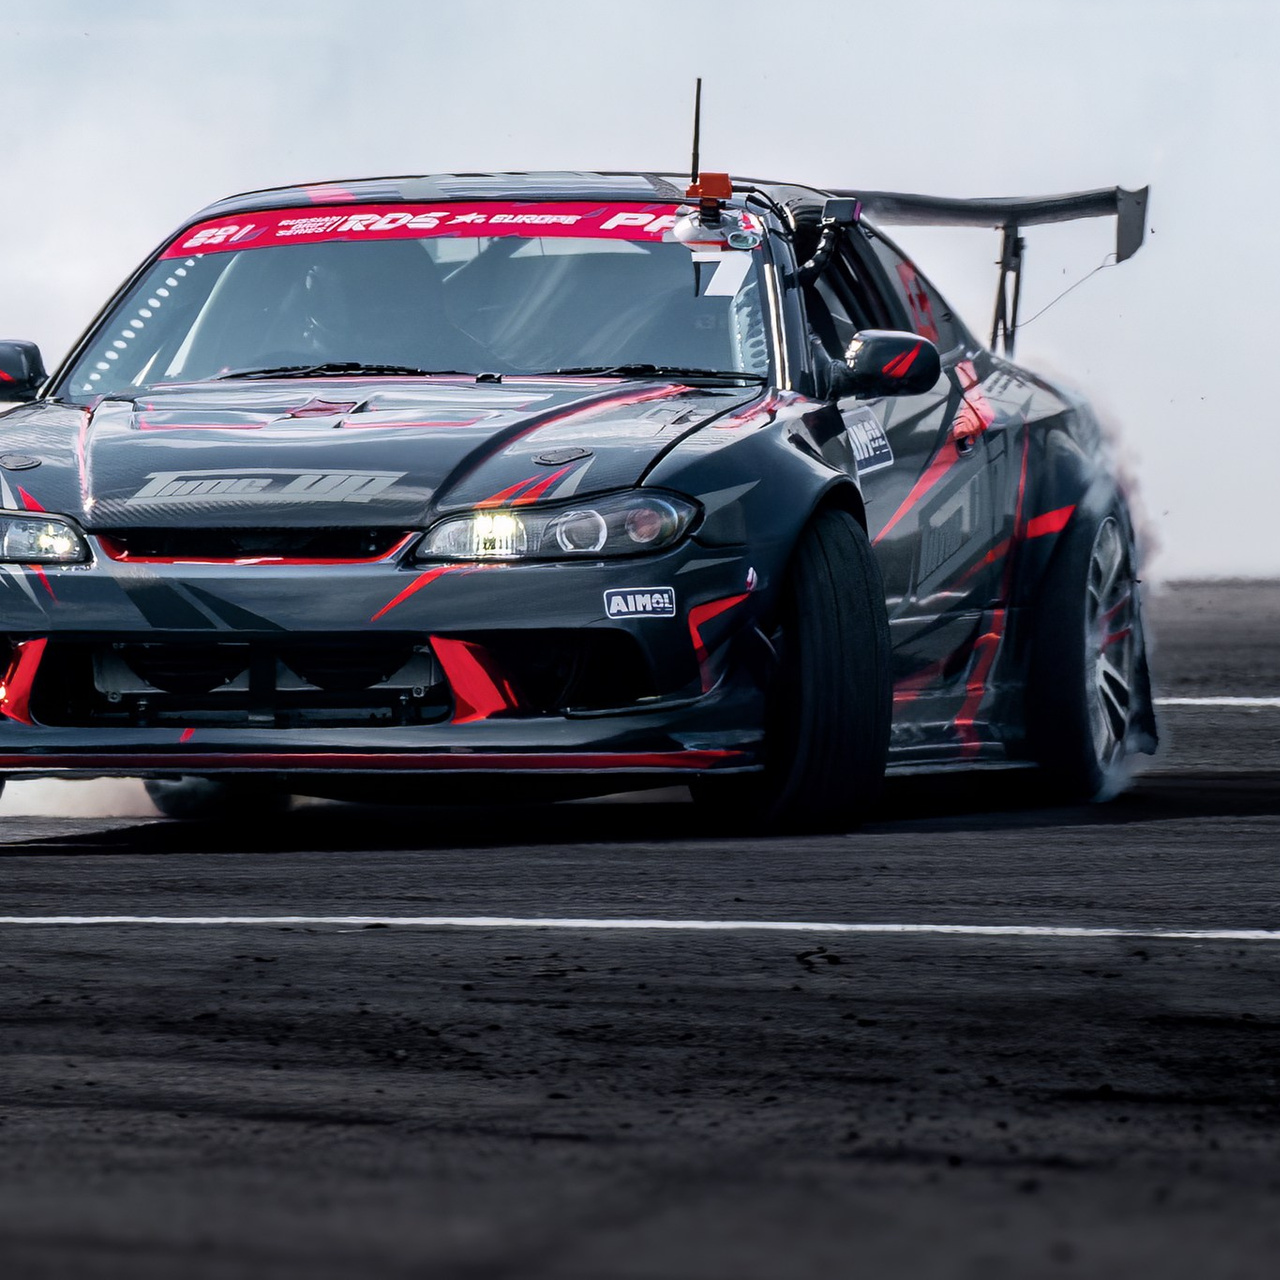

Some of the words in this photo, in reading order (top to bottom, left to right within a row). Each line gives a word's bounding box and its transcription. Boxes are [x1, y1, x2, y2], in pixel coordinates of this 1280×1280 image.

[336, 211, 451, 232] RDS
[488, 213, 582, 225] EUROPE
[609, 593, 673, 614] AIMOL
